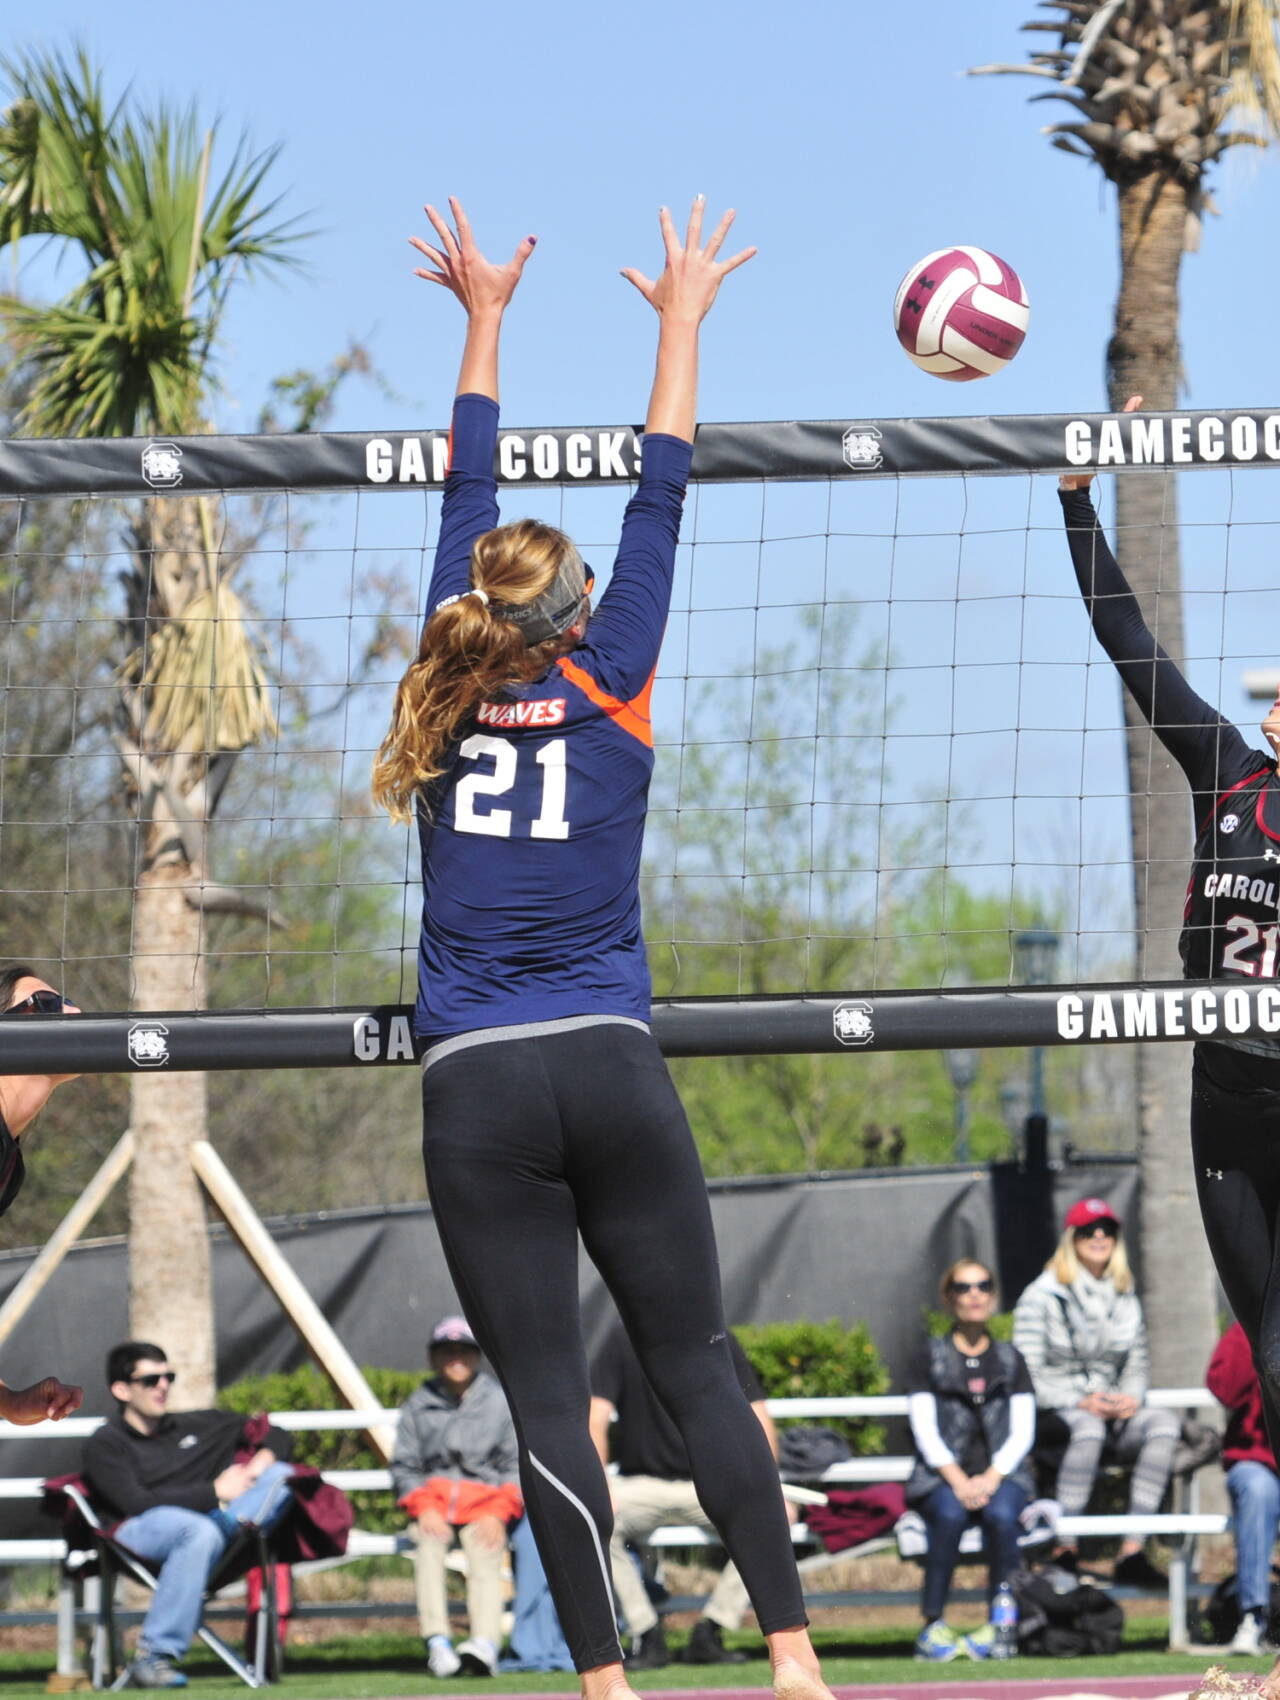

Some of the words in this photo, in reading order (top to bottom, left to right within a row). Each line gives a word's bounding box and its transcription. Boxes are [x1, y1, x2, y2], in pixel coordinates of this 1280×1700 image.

[366, 432, 641, 482] GACOCK
[478, 698, 565, 725] WAVES
[454, 733, 570, 840] 21
[1222, 914, 1279, 977] 21
